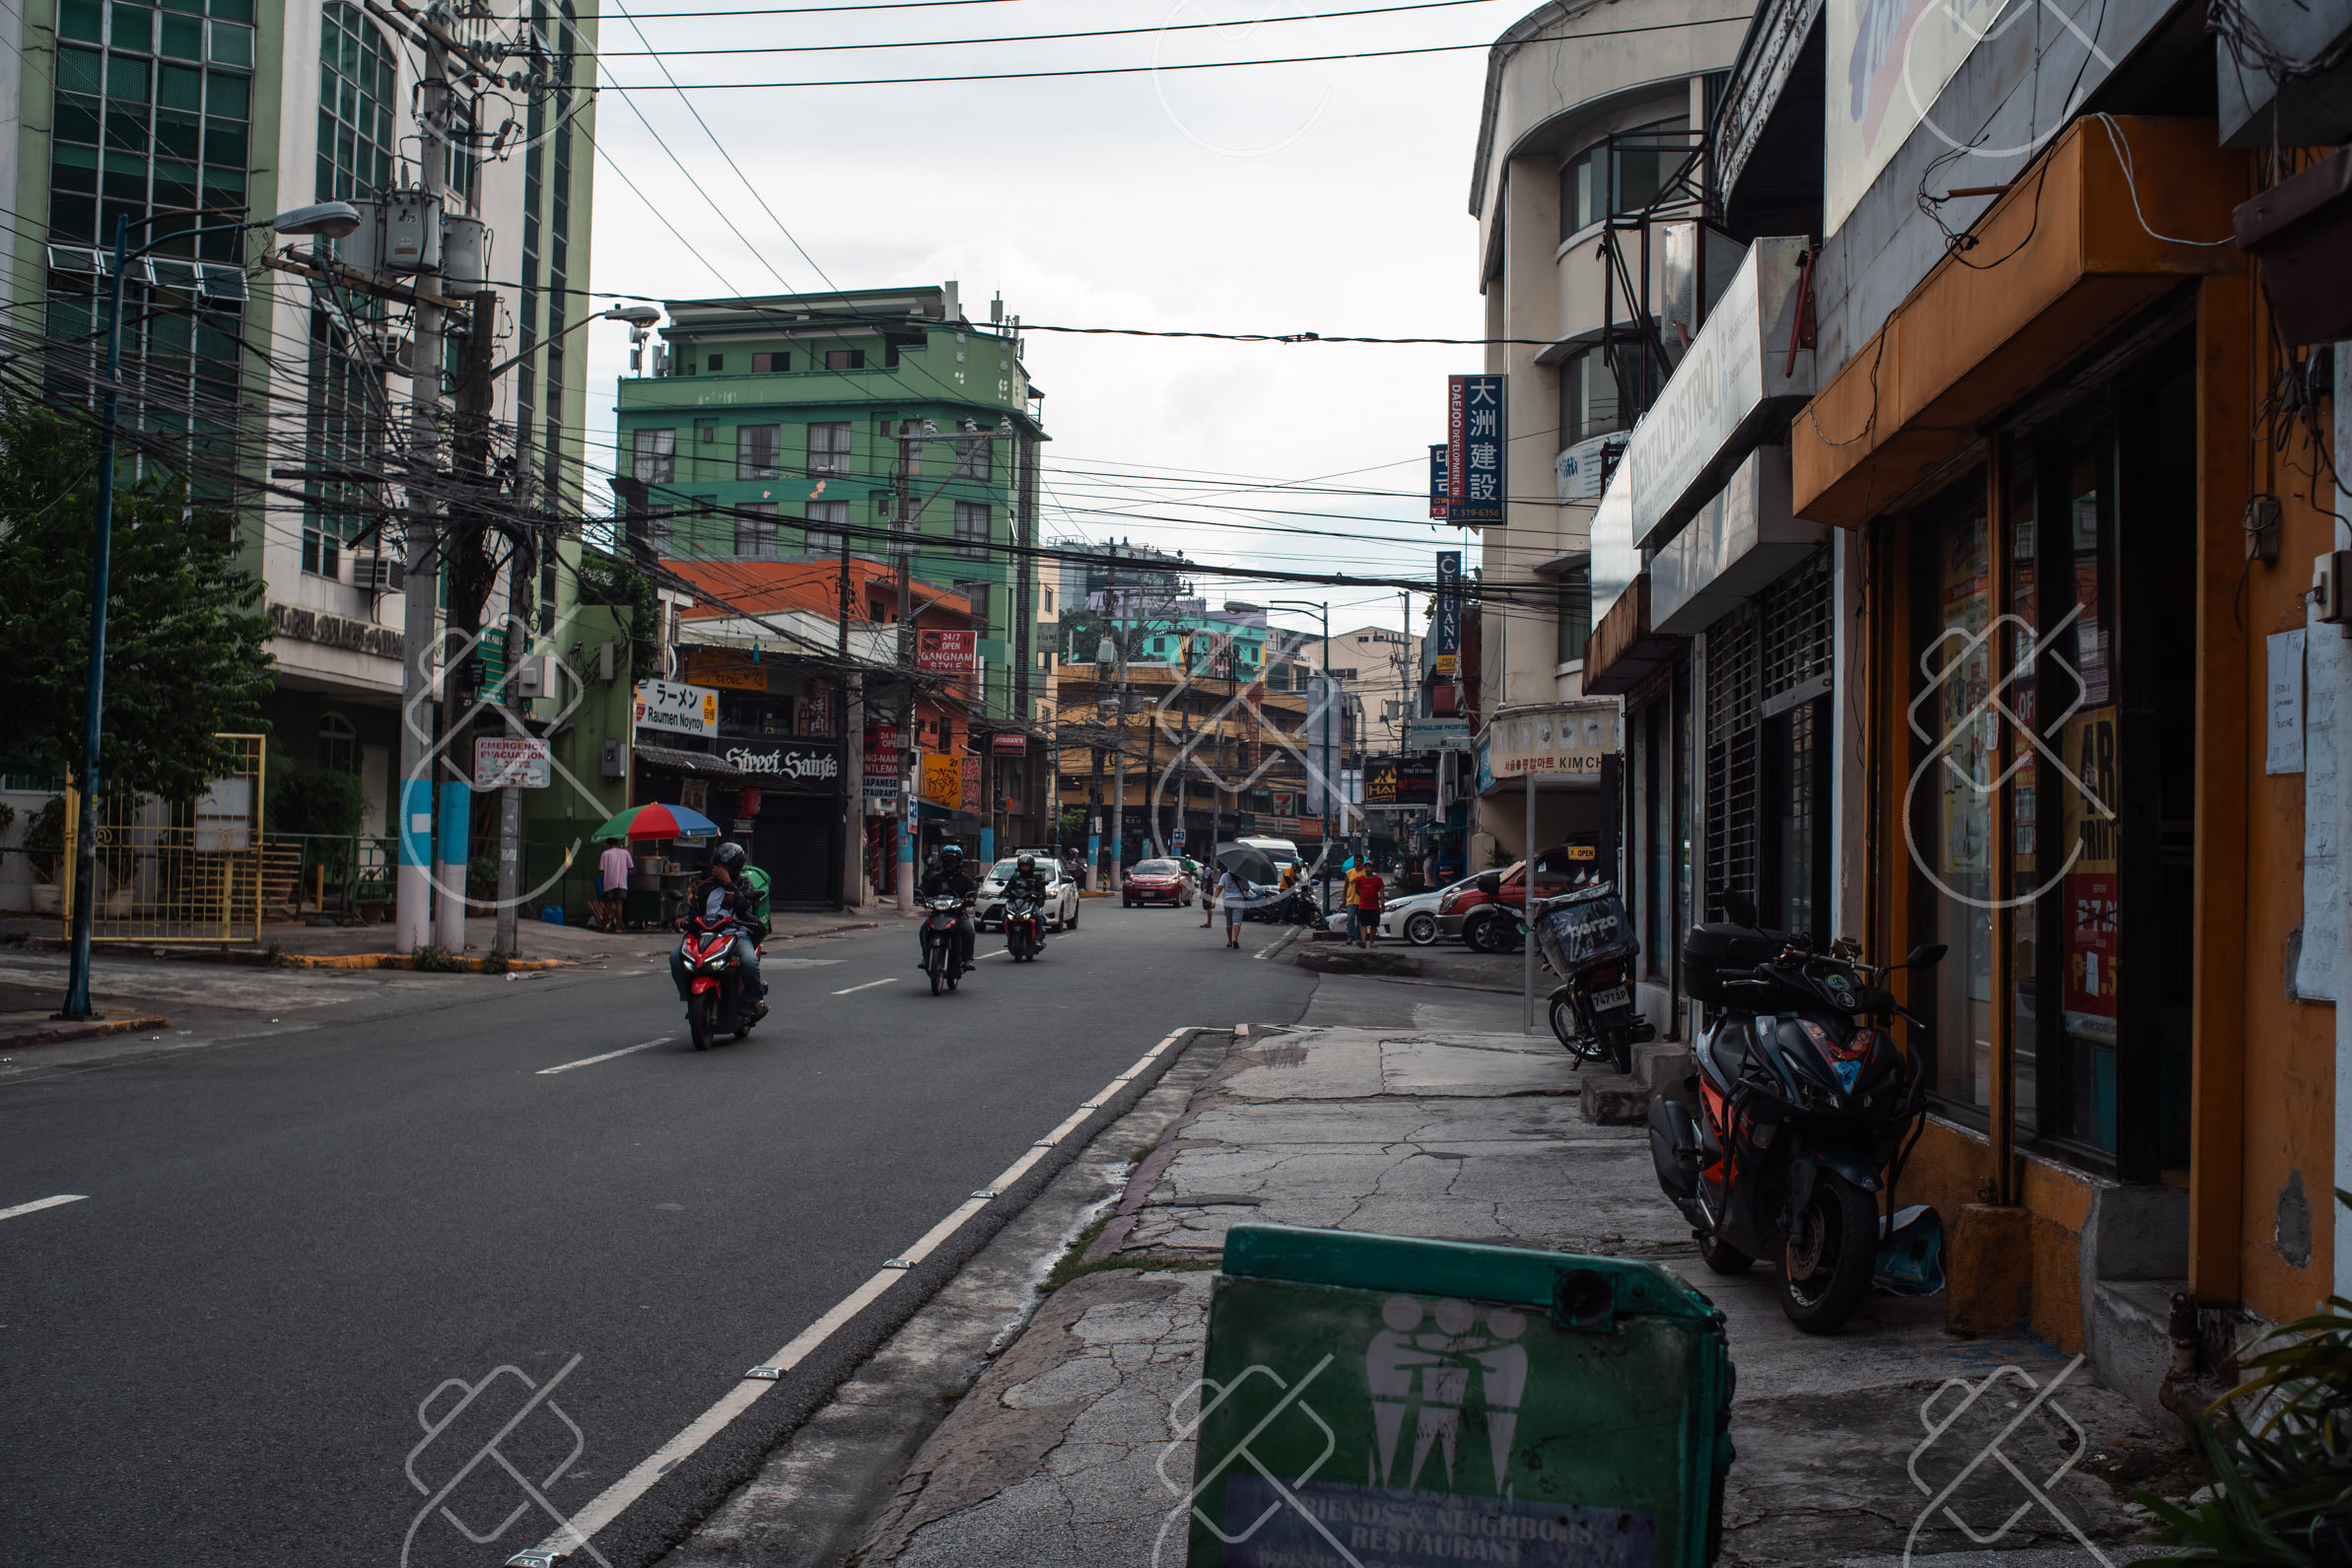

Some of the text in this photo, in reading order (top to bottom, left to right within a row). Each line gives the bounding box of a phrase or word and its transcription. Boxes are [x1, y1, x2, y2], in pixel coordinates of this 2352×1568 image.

[1452, 384, 1462, 428] DAEJOO
[1632, 348, 1714, 506] DENTAL DISTRIQ
[1470, 378, 1497, 501] 大洲建設
[1461, 508, 1499, 517] 519-6356
[942, 633, 961, 642] 24/7
[941, 642, 961, 650] OPEN
[921, 651, 973, 662] GANGNAM
[931, 661, 963, 671] STYLE
[657, 683, 698, 710] ラーメン
[2019, 690, 2036, 712] OF
[648, 706, 704, 732] Raumen Noynoy
[480, 741, 545, 750] EMERGENCY
[881, 739, 898, 749] OPE
[995, 736, 1024, 745] JORDAN'S
[480, 751, 545, 760] EVACUATION
[865, 754, 898, 763] NG-NAM
[726, 747, 838, 781] Street Saints
[949, 758, 958, 767] 2F
[1559, 756, 1602, 769] KIMCH
[864, 788, 897, 798] STAURANT
[1435, 1507, 1594, 1546] NEIGHBORS
[1350, 1526, 1522, 1564] RESTAURANT
